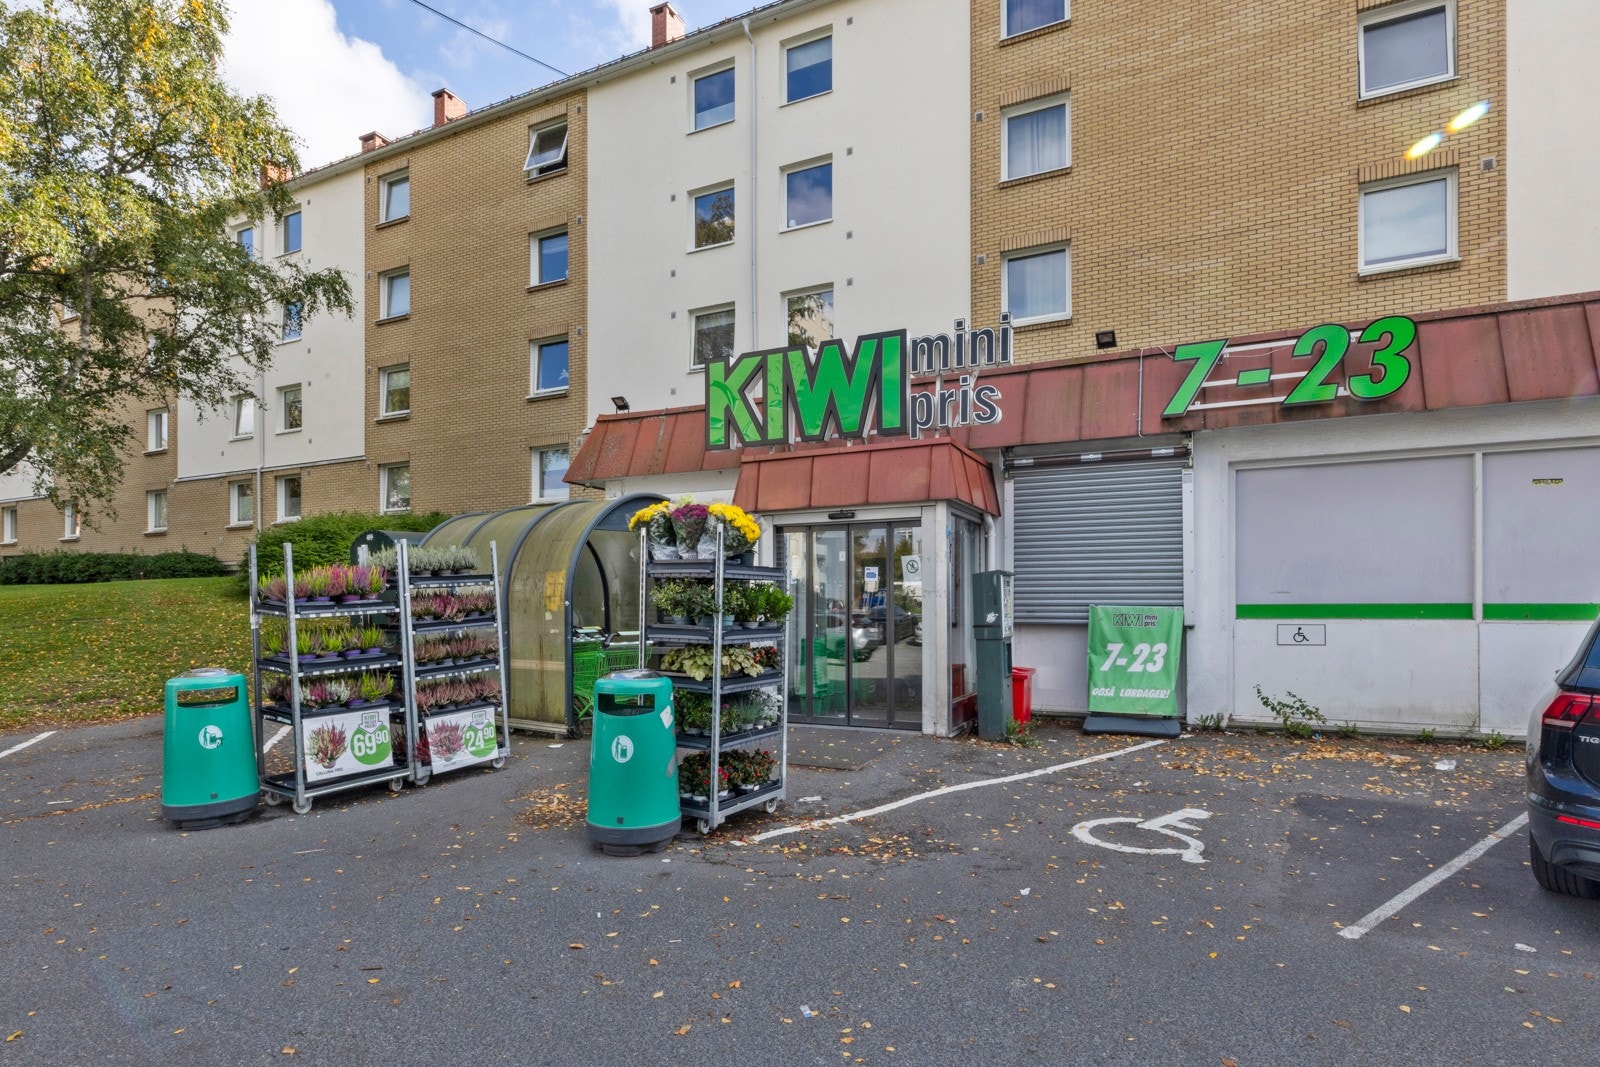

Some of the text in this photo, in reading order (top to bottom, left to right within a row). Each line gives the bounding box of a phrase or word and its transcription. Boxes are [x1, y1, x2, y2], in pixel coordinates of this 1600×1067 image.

[909, 311, 1013, 375] mini
[1160, 315, 1417, 418] 7-23
[705, 328, 906, 449] KIWI
[909, 375, 1002, 440] pris
[1112, 613, 1144, 627] KIWI
[1144, 613, 1158, 621] mini
[1144, 620, 1156, 628] pris
[1100, 642, 1168, 673] 7-23
[1091, 686, 1170, 699] OGSÅ LØRDAGER!
[1578, 735, 1600, 744] TIG
